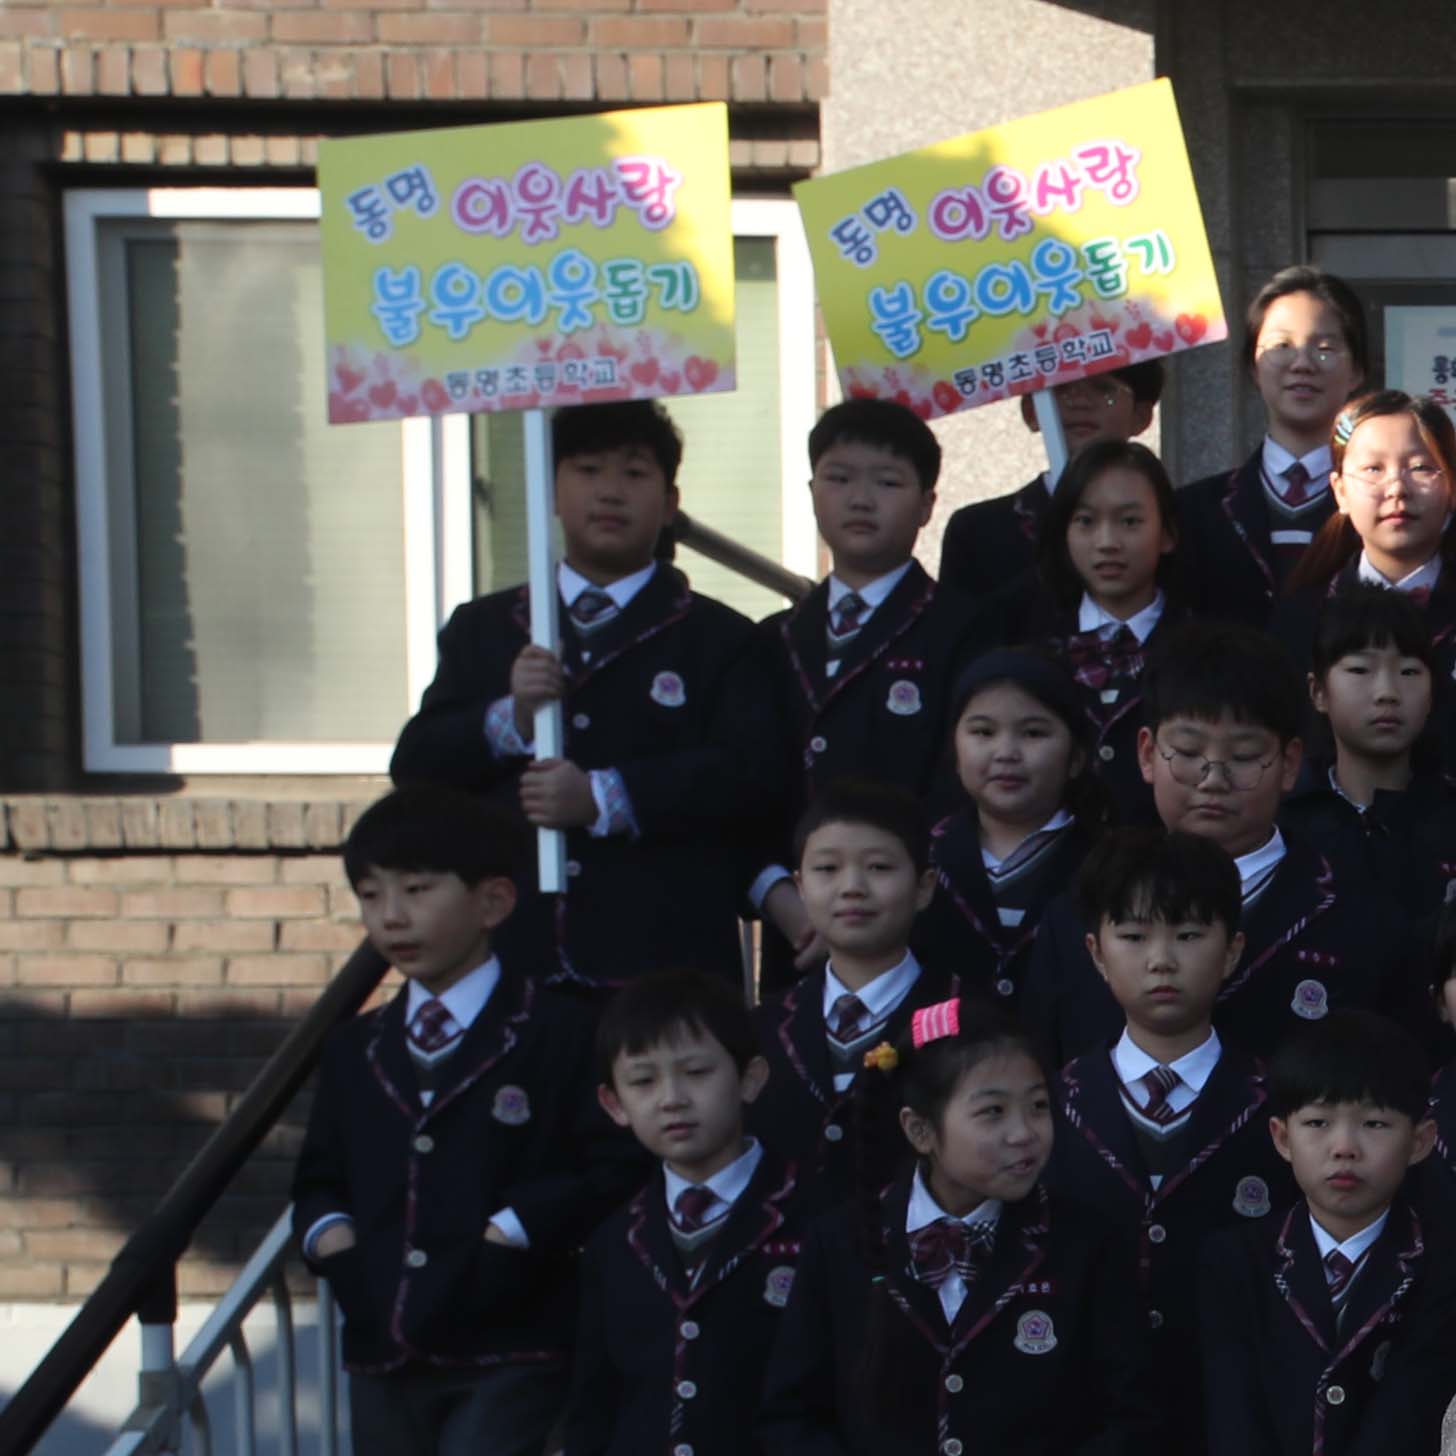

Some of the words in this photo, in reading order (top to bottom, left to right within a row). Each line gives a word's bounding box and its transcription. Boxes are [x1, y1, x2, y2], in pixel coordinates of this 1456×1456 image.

[348, 163, 438, 242] 동명
[453, 156, 682, 245] 이웃사랑
[828, 188, 915, 266] 동명
[930, 140, 1141, 239] 이웃사랑
[370, 250, 699, 347] 불우이웃돕기
[868, 229, 1176, 358] 불우이웃돕기
[447, 358, 617, 397] 동명초등학교
[952, 330, 1115, 397] 동명초등학교
